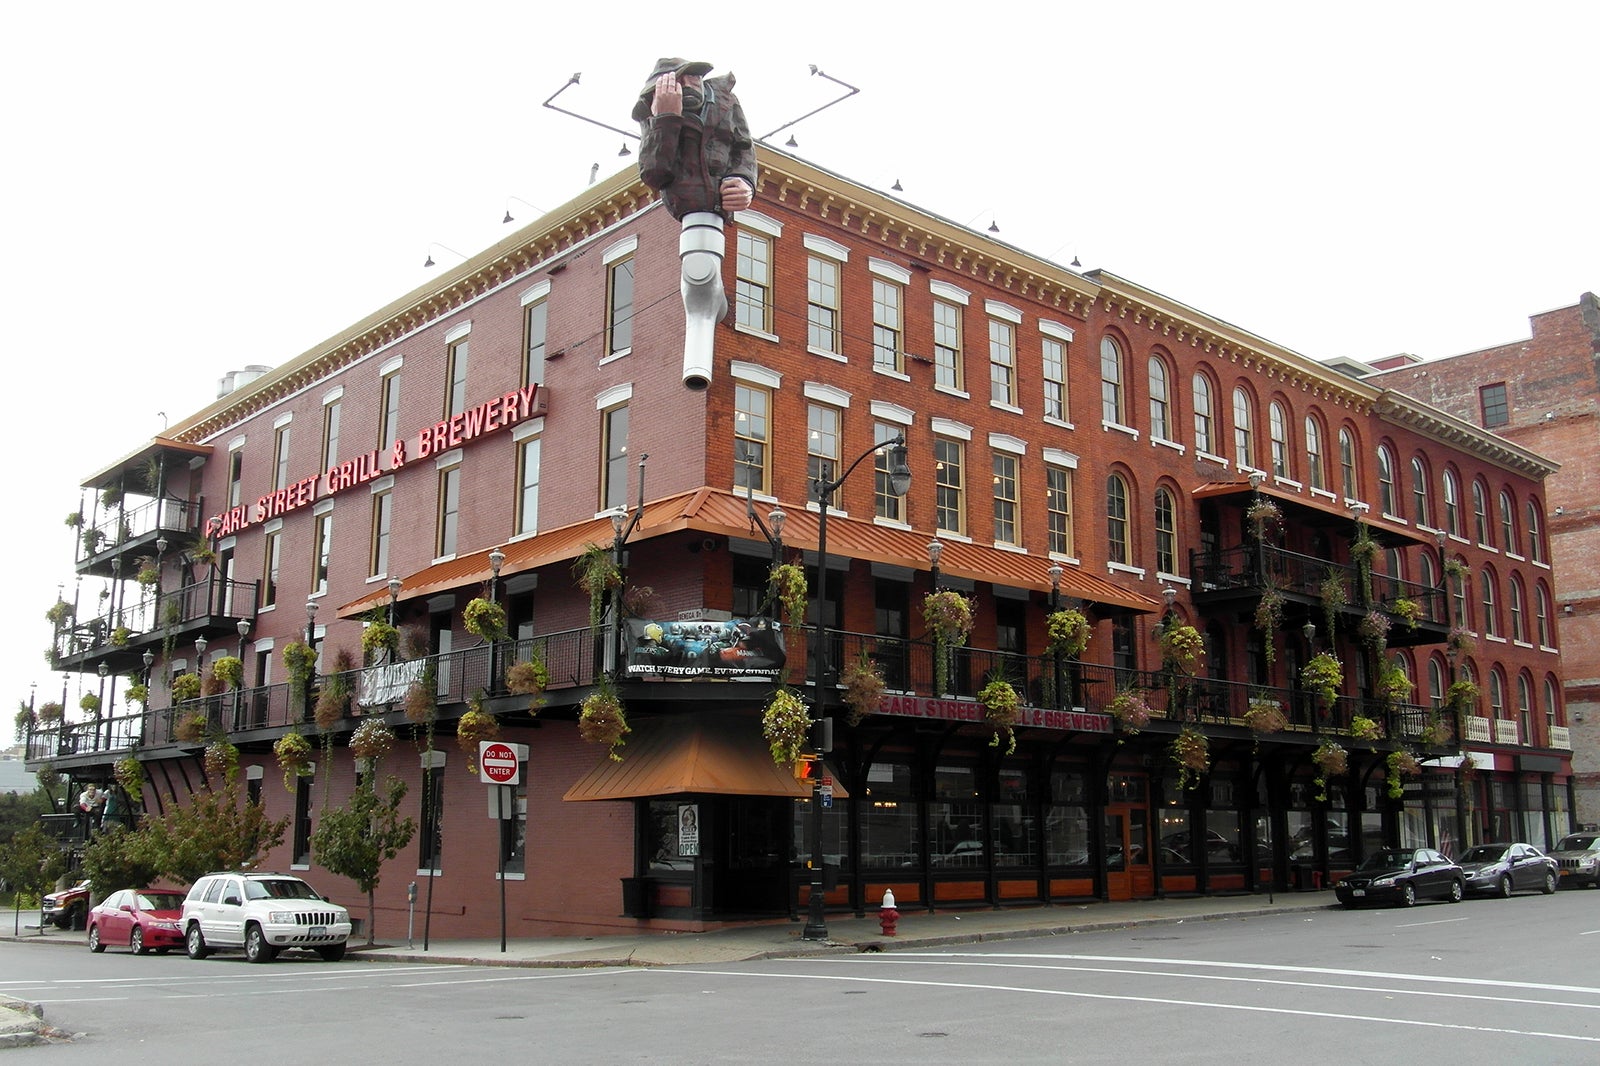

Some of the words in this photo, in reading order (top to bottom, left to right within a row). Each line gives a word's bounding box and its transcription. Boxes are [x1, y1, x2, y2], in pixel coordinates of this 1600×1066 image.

[256, 476, 317, 523] STREET
[326, 450, 382, 495] GRILL
[391, 439, 407, 470] &
[418, 383, 538, 459] BREWERY
[628, 664, 656, 673] WATCH
[656, 665, 685, 675] EVERY
[879, 696, 922, 716] EARL
[926, 699, 986, 720] STREET
[1045, 711, 1109, 731] BREWERY
[679, 843, 700, 855] OPEN
